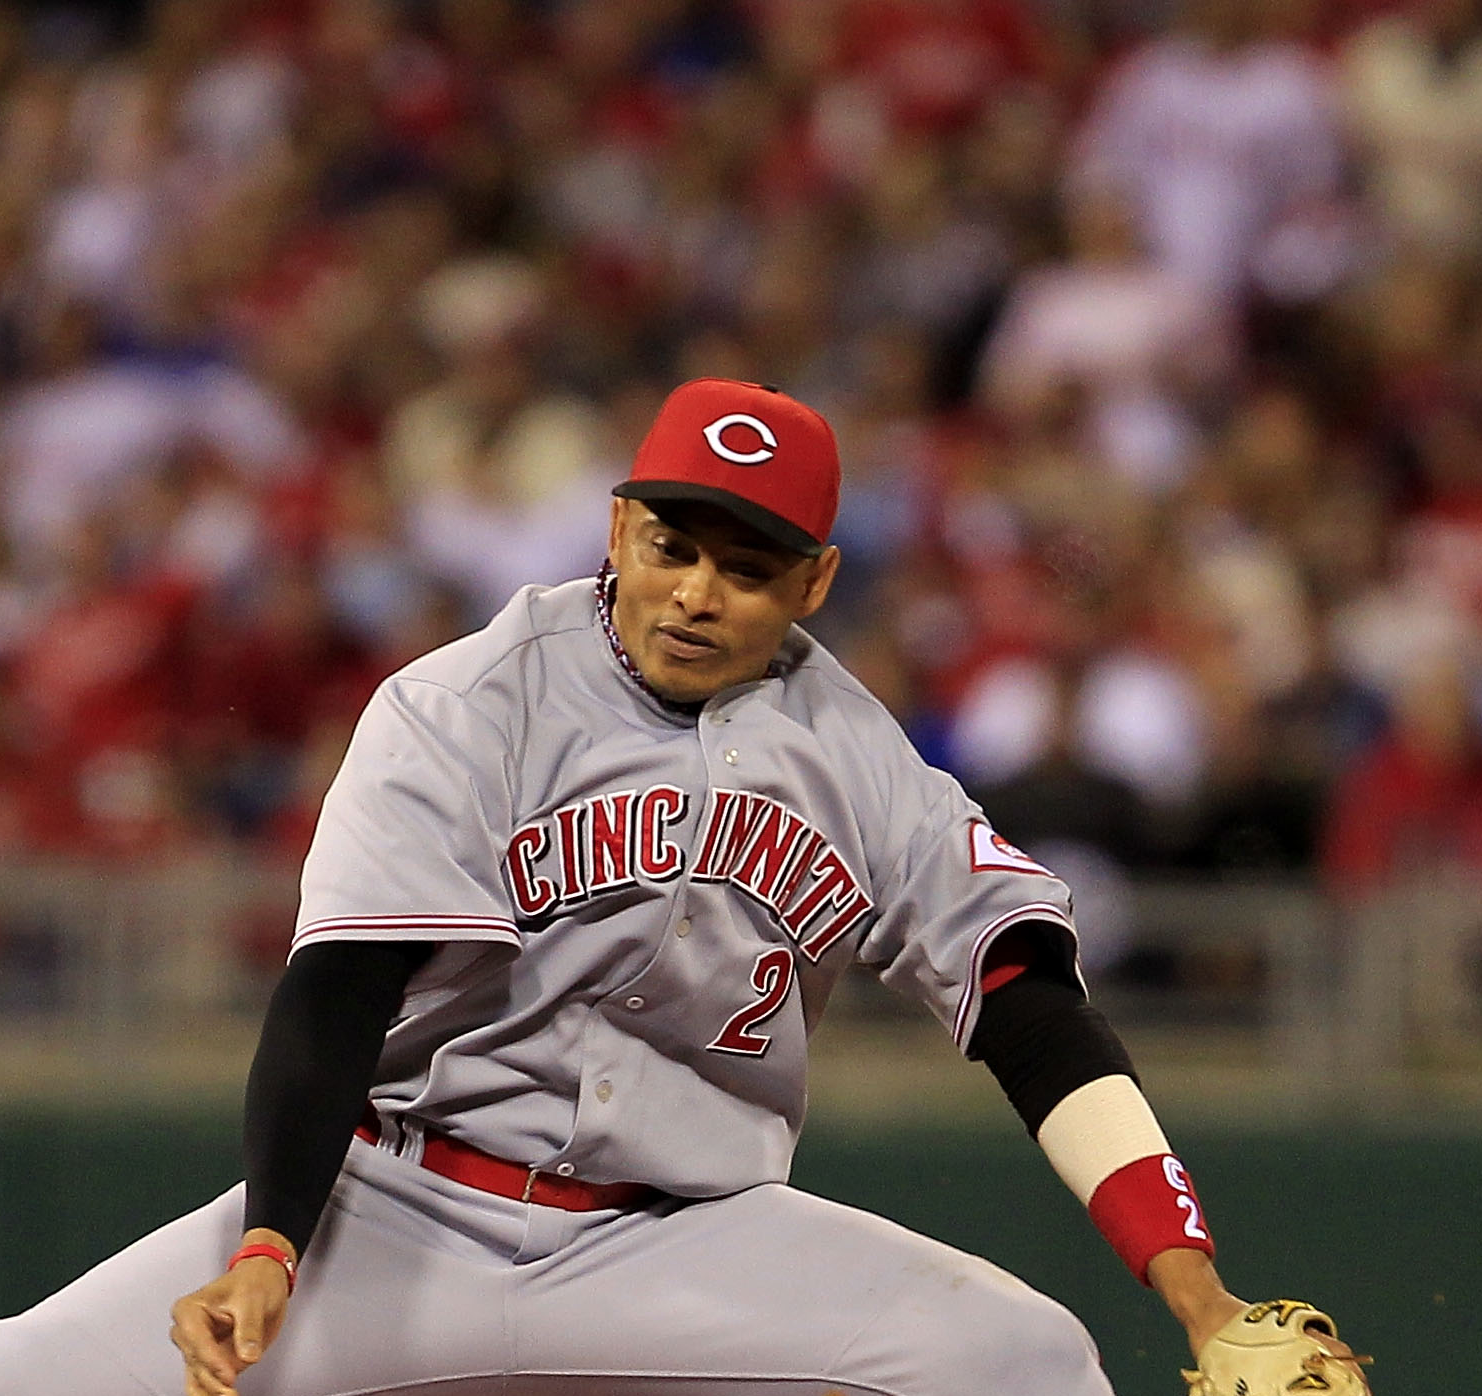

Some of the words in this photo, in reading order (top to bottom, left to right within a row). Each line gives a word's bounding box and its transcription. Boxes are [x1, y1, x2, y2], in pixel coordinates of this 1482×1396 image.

[702, 412, 779, 465] C
[705, 946, 796, 1057] 2
[1176, 1193, 1208, 1241] 2
